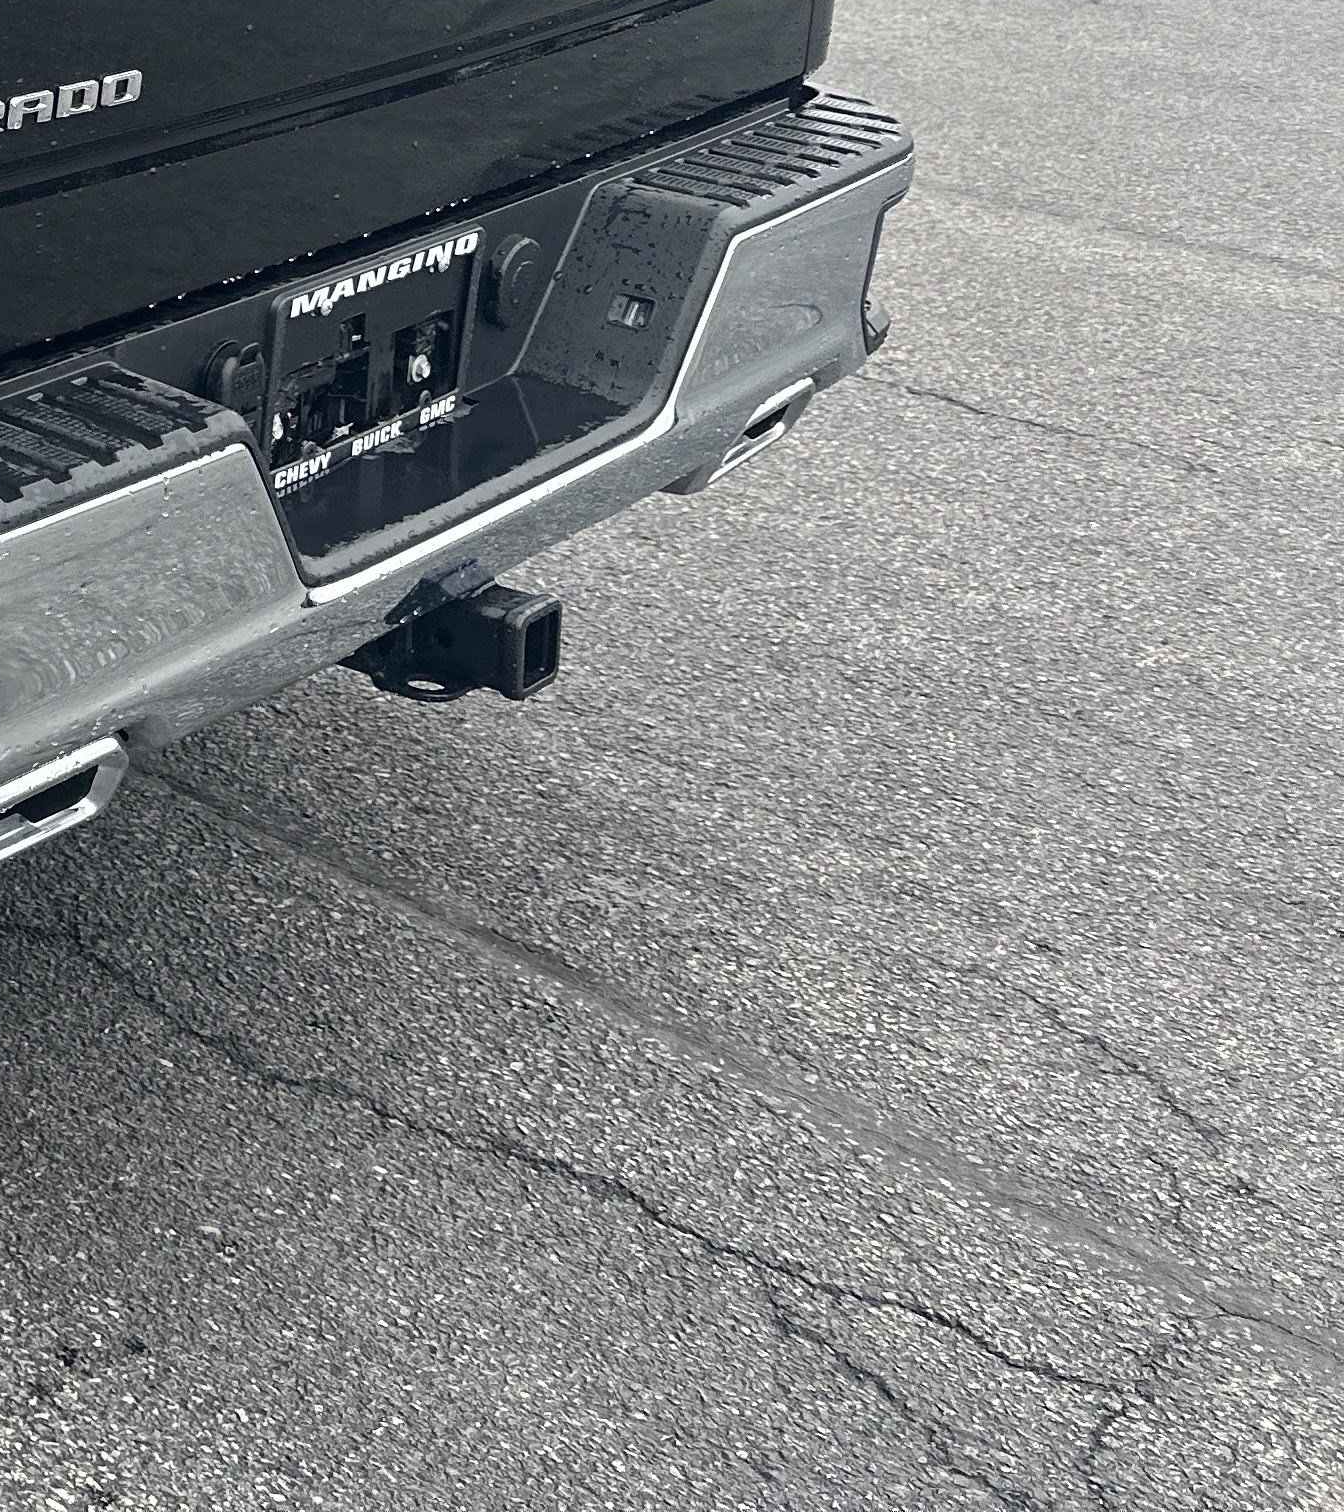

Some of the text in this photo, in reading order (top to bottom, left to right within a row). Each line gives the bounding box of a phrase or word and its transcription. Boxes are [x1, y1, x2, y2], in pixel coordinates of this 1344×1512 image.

[290, 232, 479, 319] MANGINO
[273, 395, 456, 490] CHEVY BUICK GMC
